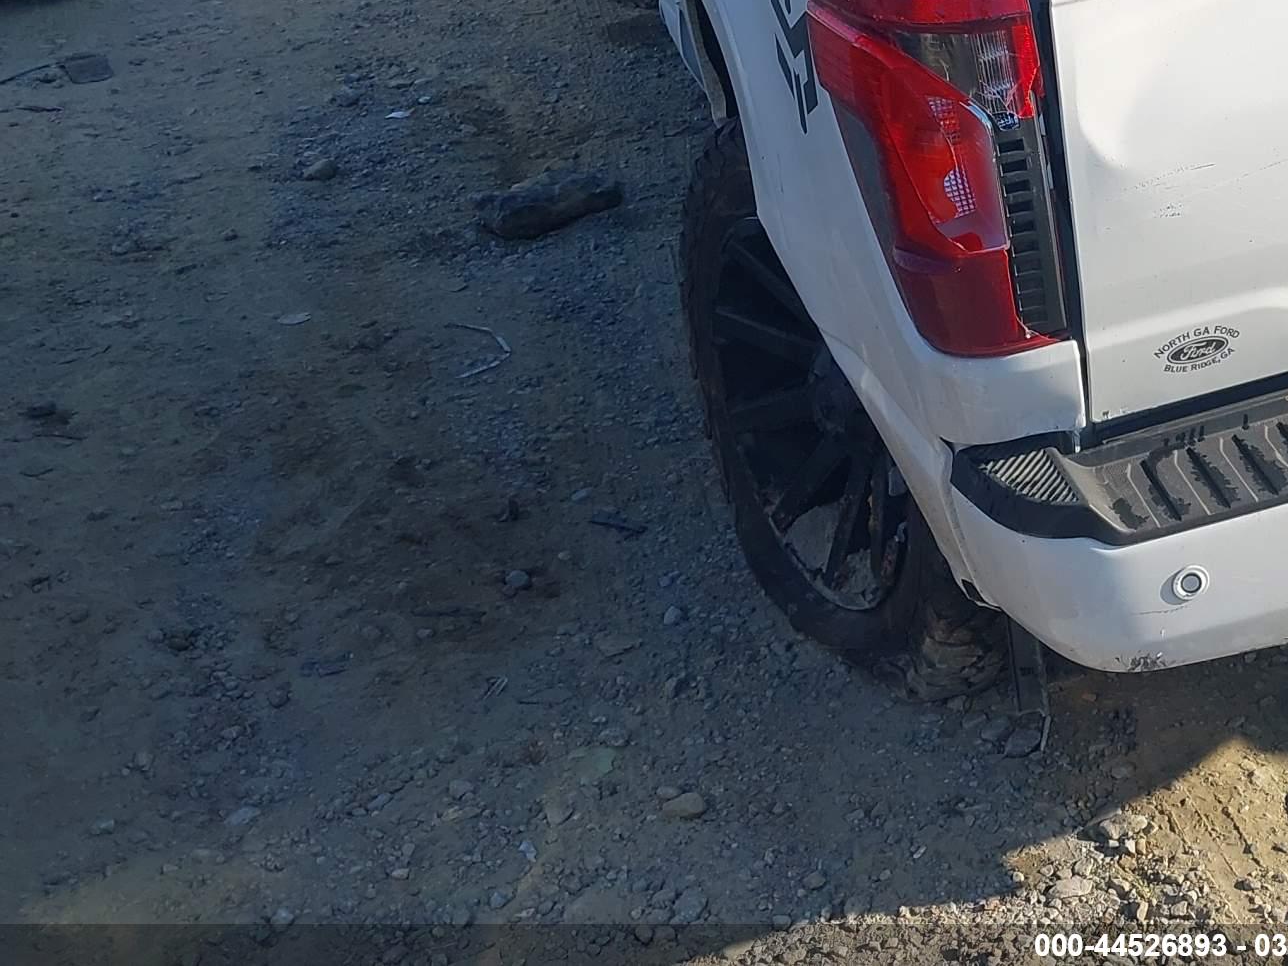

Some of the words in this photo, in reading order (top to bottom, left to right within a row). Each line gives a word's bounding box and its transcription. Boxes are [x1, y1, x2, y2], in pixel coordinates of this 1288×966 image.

[1153, 332, 1190, 358] NORTH
[1193, 327, 1210, 336] GA
[1214, 326, 1240, 338] FORD
[1180, 342, 1216, 360] Ford
[1164, 364, 1188, 372] BLUE
[1191, 358, 1221, 371] RIDGE,
[1221, 348, 1235, 358] GA
